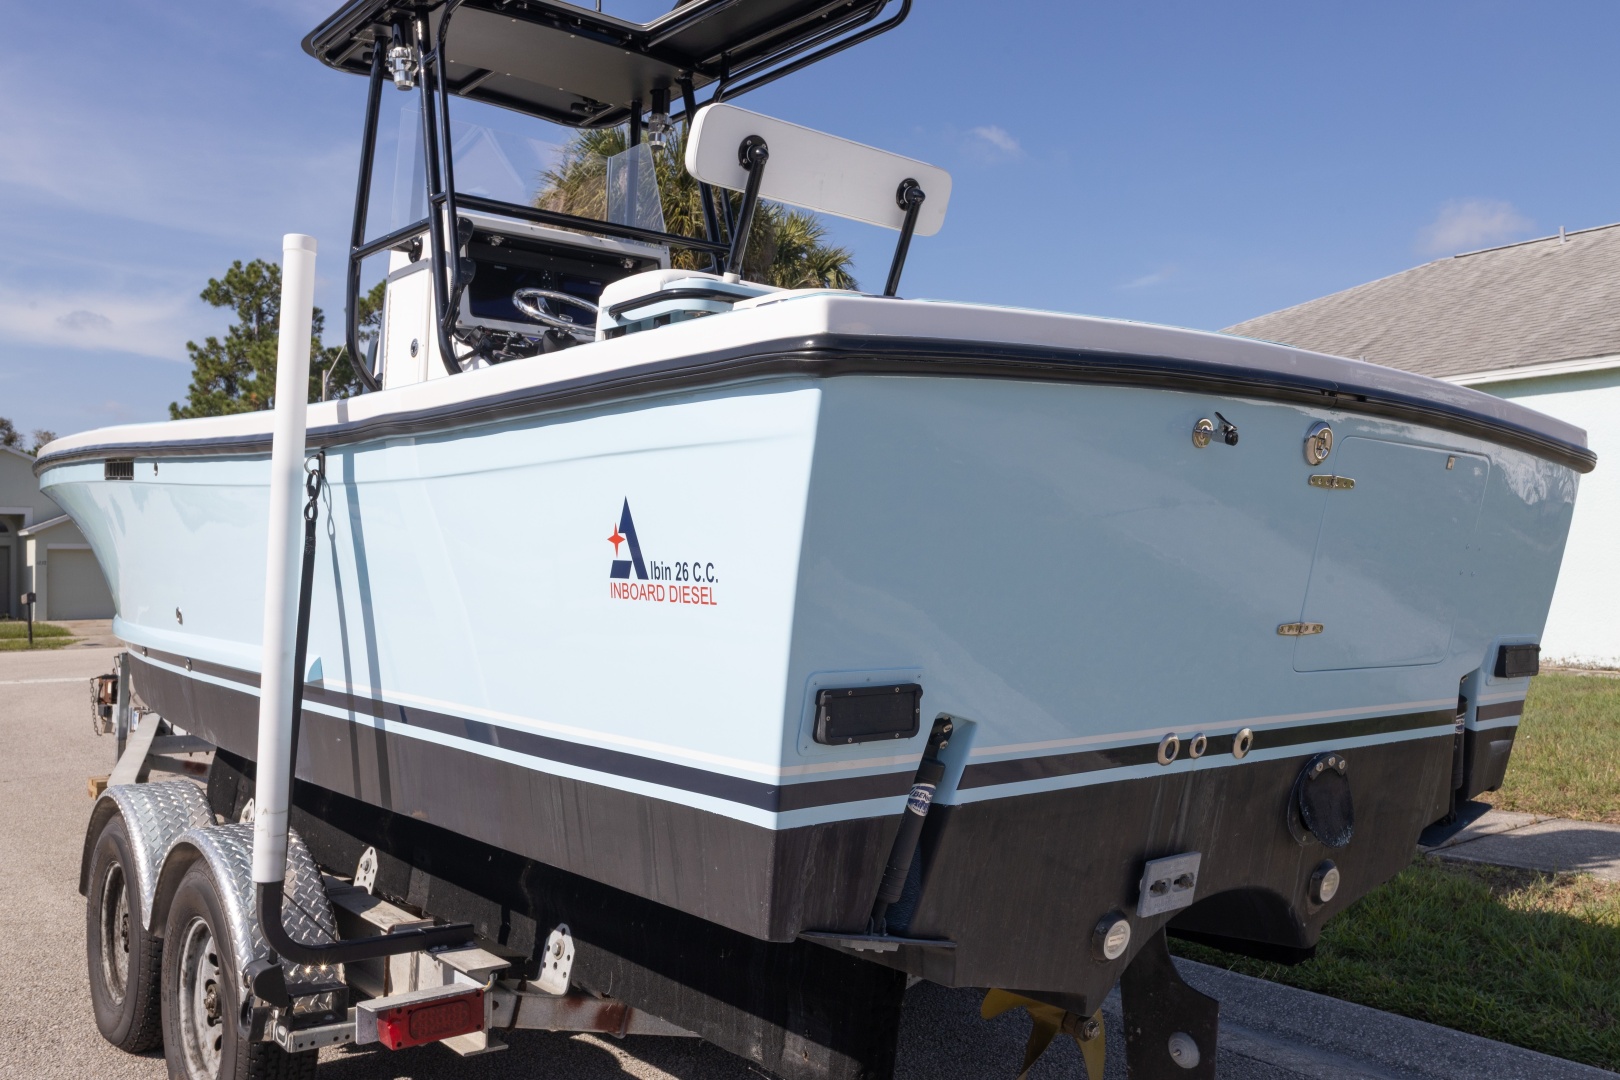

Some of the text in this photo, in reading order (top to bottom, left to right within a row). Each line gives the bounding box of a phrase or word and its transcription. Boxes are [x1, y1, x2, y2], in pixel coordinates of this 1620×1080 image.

[608, 495, 719, 583] Albin 26 C.C.
[610, 582, 718, 605] INBOARD DIESEL
